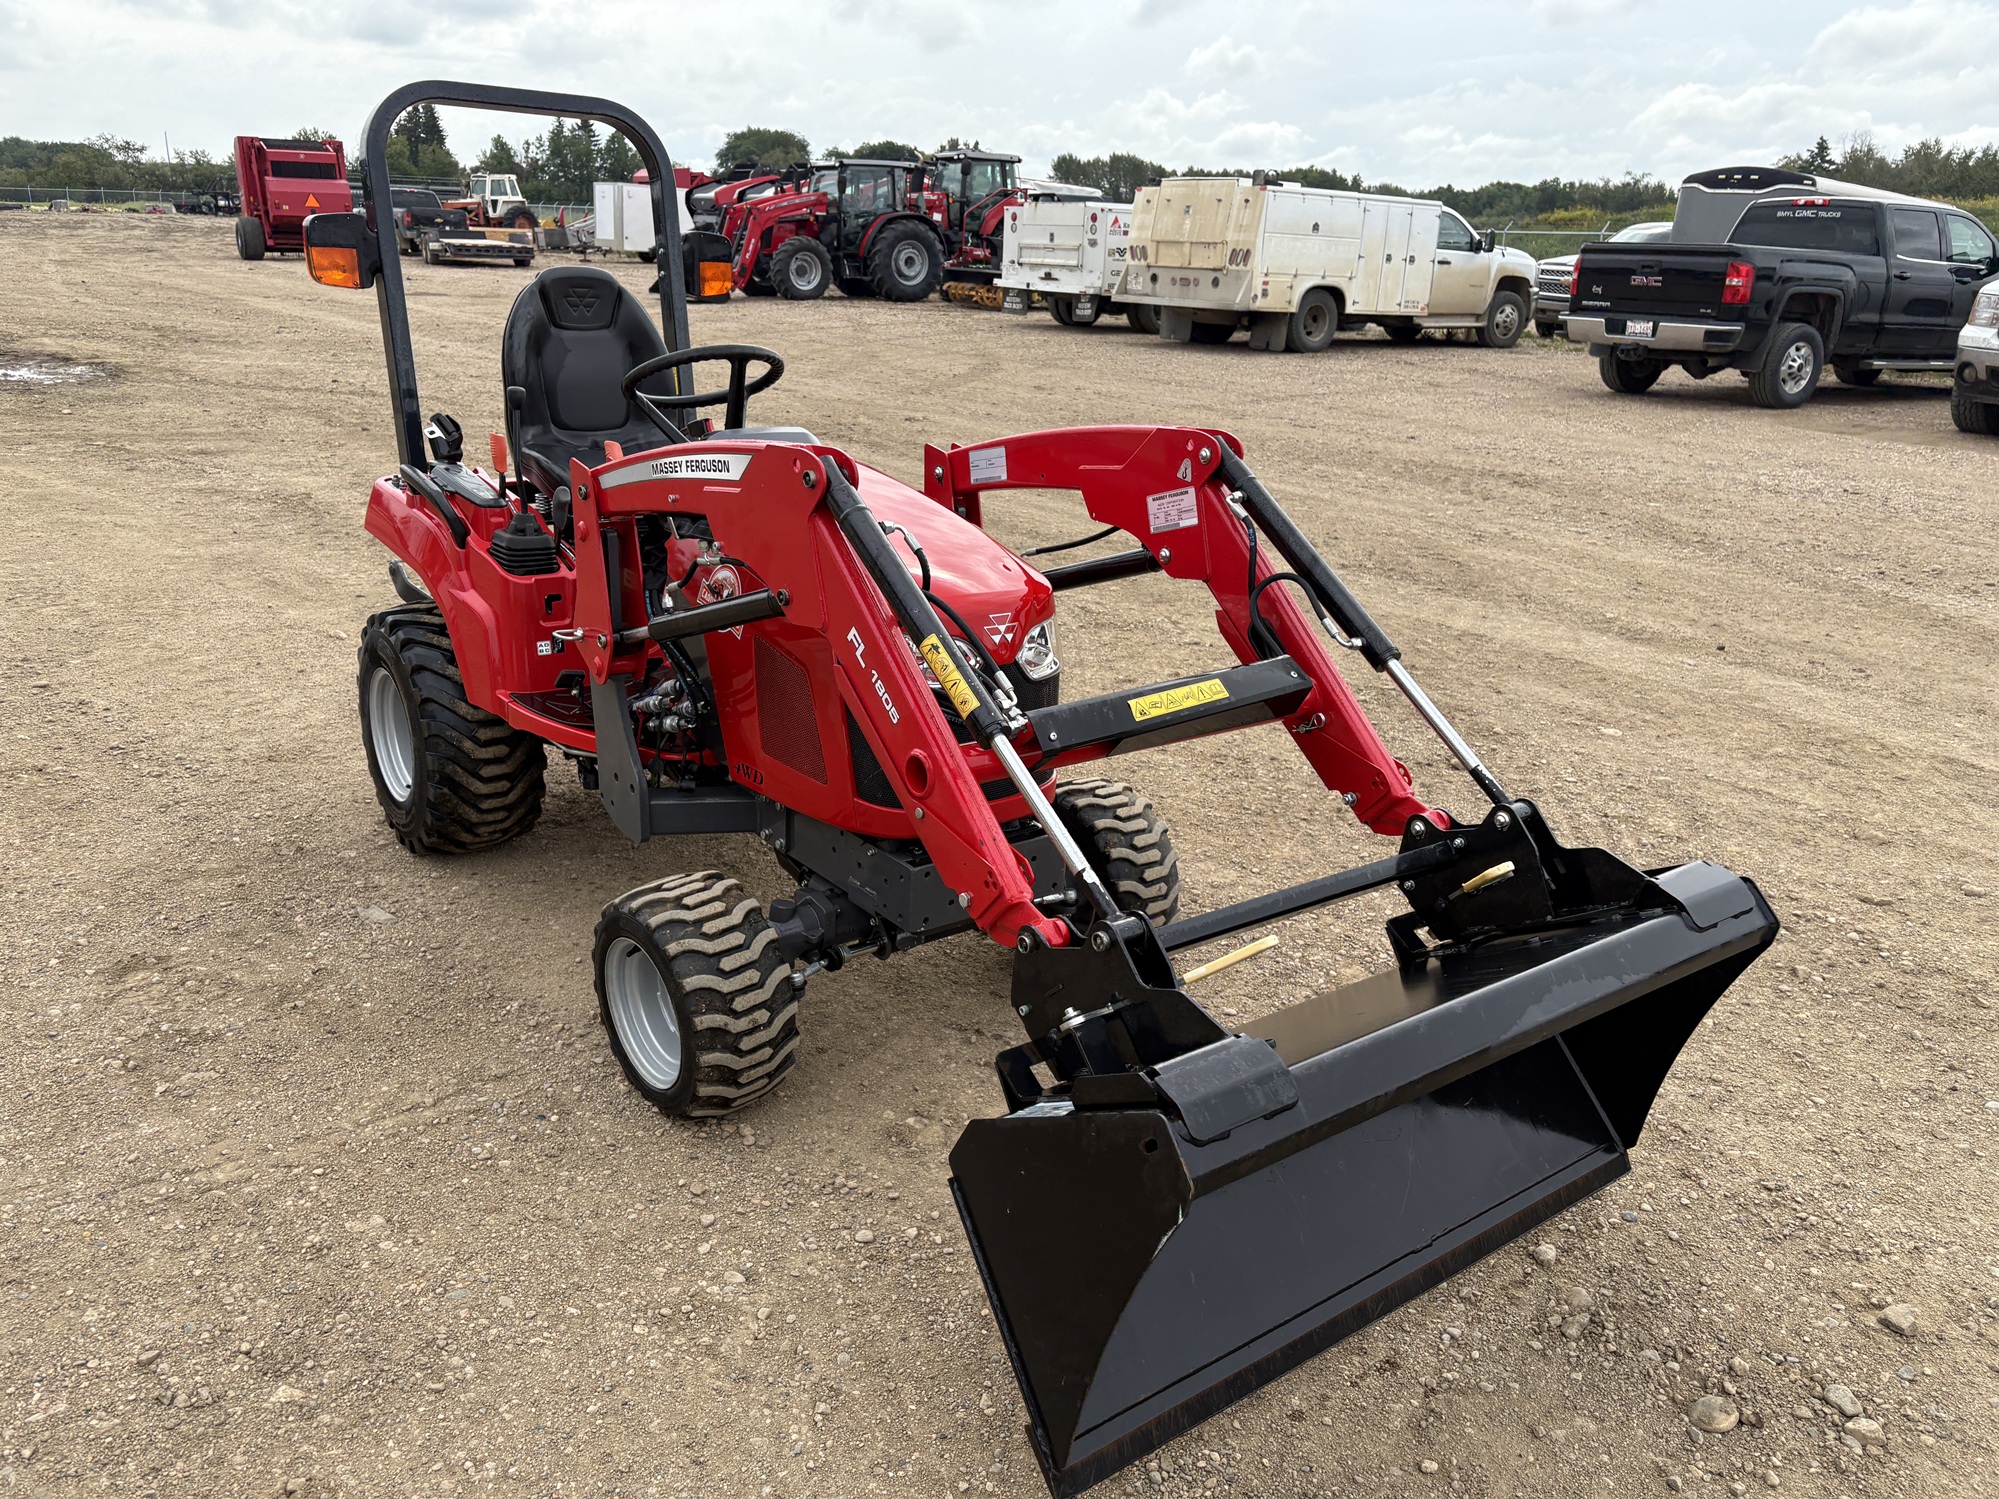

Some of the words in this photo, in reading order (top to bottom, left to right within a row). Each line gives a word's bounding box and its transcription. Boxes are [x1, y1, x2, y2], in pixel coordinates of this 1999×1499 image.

[1630, 275, 1663, 287] GMC
[651, 460, 683, 475] MASSEY
[685, 459, 730, 473] FERGUSON
[1152, 494, 1168, 502] MASSEY
[1168, 490, 1189, 499] FERGUSON
[846, 626, 866, 669] FL
[871, 669, 900, 724] 1805
[734, 761, 764, 785] 4WD
